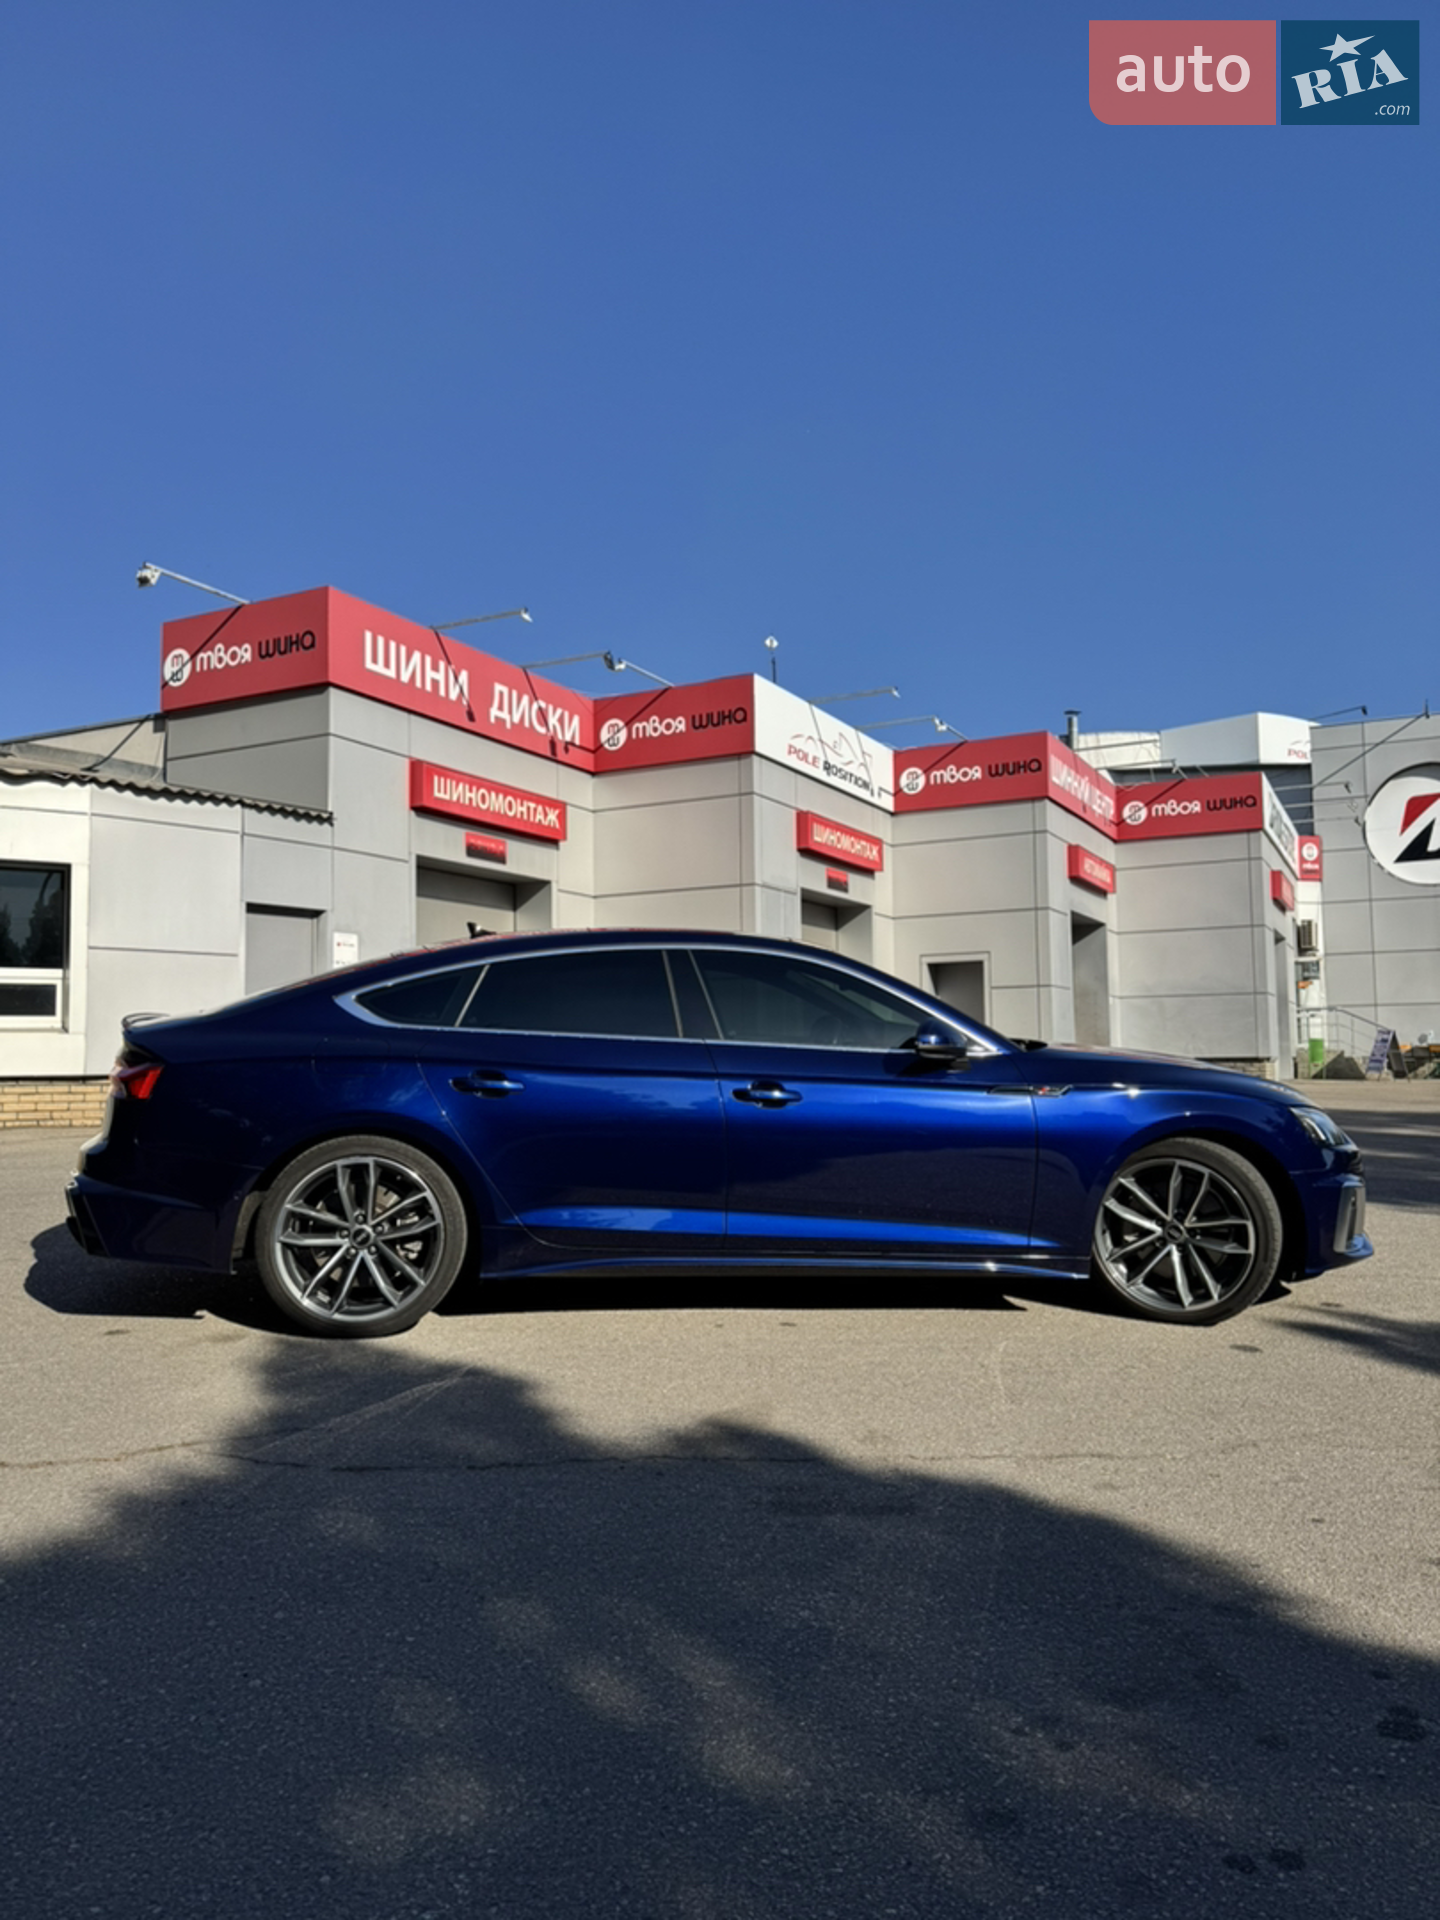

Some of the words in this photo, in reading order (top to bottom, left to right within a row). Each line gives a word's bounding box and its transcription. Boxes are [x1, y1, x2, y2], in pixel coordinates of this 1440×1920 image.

[195, 642, 252, 673] твоя
[258, 629, 316, 660] шина
[363, 629, 469, 706] ШИНИ
[489, 681, 580, 746] ДИСКИ
[631, 715, 686, 741] твоя
[691, 706, 748, 731] шина
[787, 743, 820, 769] POLE
[433, 774, 560, 830] ШИНОМОНТАЖ
[812, 822, 881, 861] ШИНОМОНТАЖ
